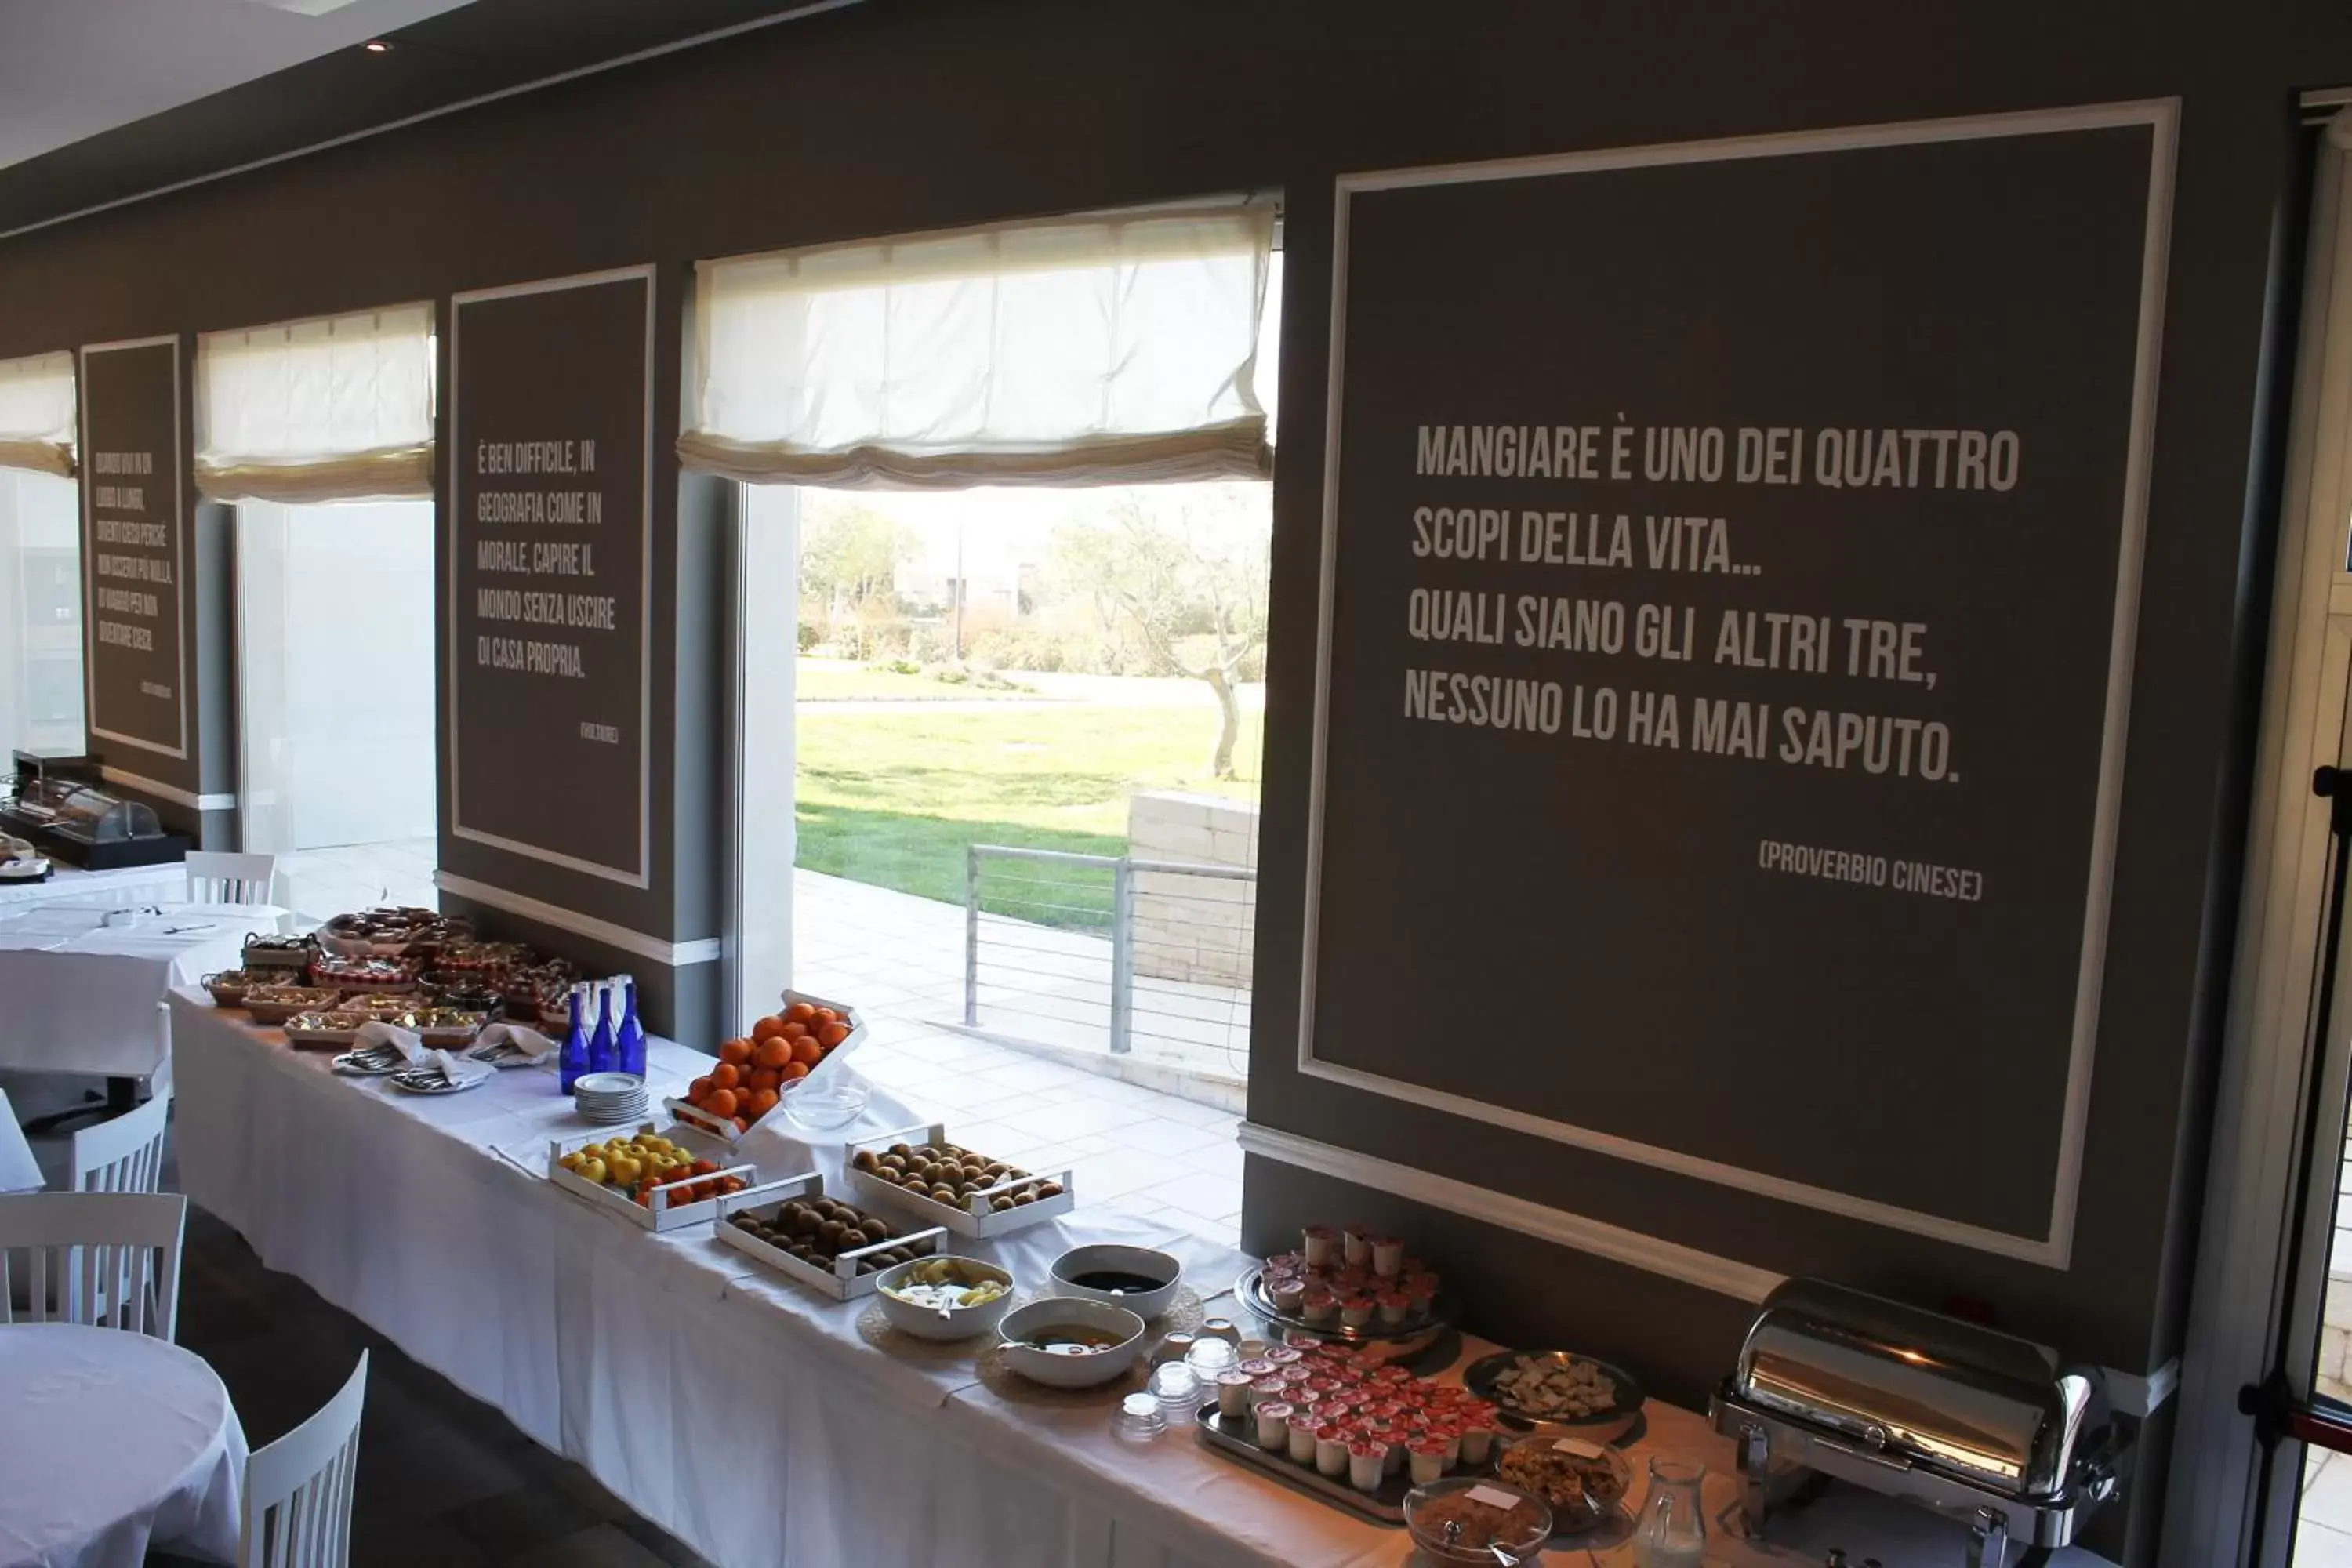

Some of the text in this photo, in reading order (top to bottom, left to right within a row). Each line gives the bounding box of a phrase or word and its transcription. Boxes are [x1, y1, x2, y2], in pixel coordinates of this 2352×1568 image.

[477, 439, 595, 476] È BEN DIFFICILE, IN
[1416, 412, 2019, 492] MANGIARE È UNO DEI QUATTRO
[477, 491, 602, 524] GEOGRAFIA COME IN
[477, 539, 596, 576] MORALE, CAPIRE IL
[1412, 506, 1762, 575] SCOPI DELLA VITA...
[477, 587, 615, 630] MONDO SENZA USCIRE
[477, 635, 586, 679] DI CASA PROPRIA.
[1408, 587, 1936, 691] QUALI SIANO GLI ALTRI TRE,
[1404, 669, 1959, 782] NESSUNO LO HA MAI SAPUTO.
[1759, 840, 1983, 902] (PROVERBIO CINESE)
